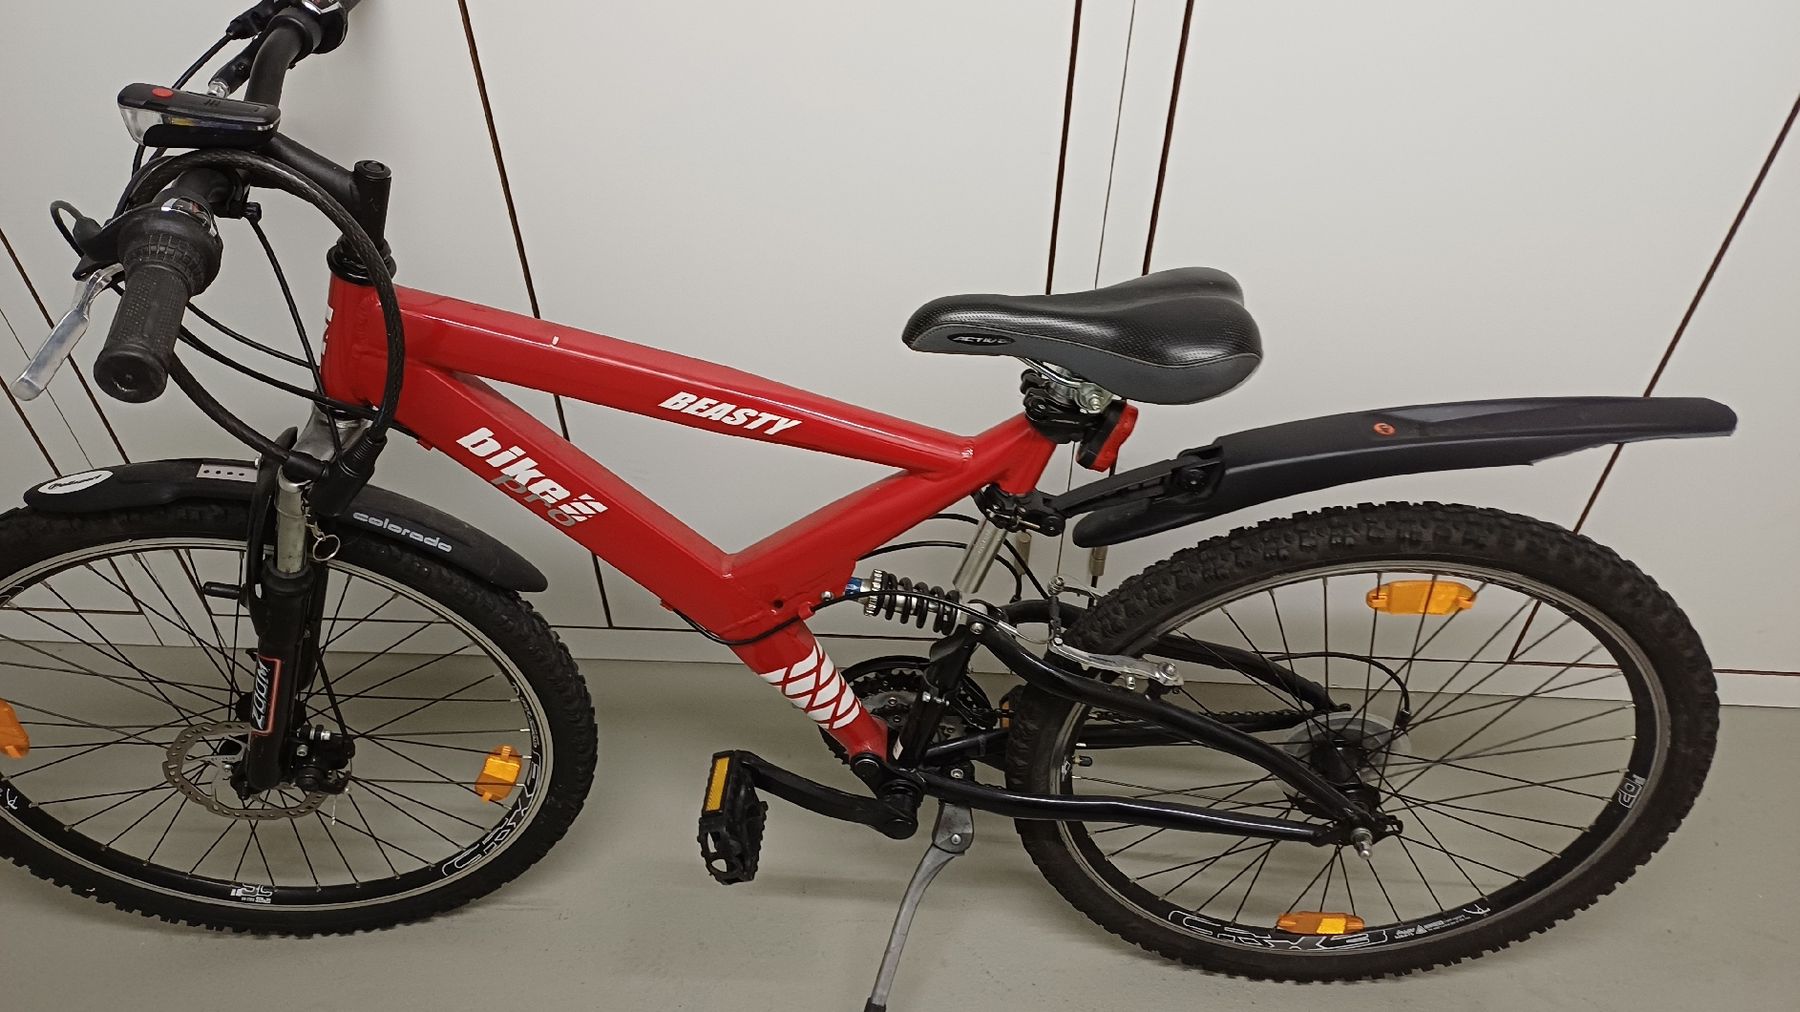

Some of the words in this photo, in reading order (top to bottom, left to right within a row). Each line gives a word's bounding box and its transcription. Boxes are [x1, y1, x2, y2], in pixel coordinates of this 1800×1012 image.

[657, 391, 803, 435] BEASTY
[455, 427, 571, 504] bike
[490, 474, 577, 527] pro
[353, 511, 453, 553] colorado
[251, 658, 271, 730] ZOOM
